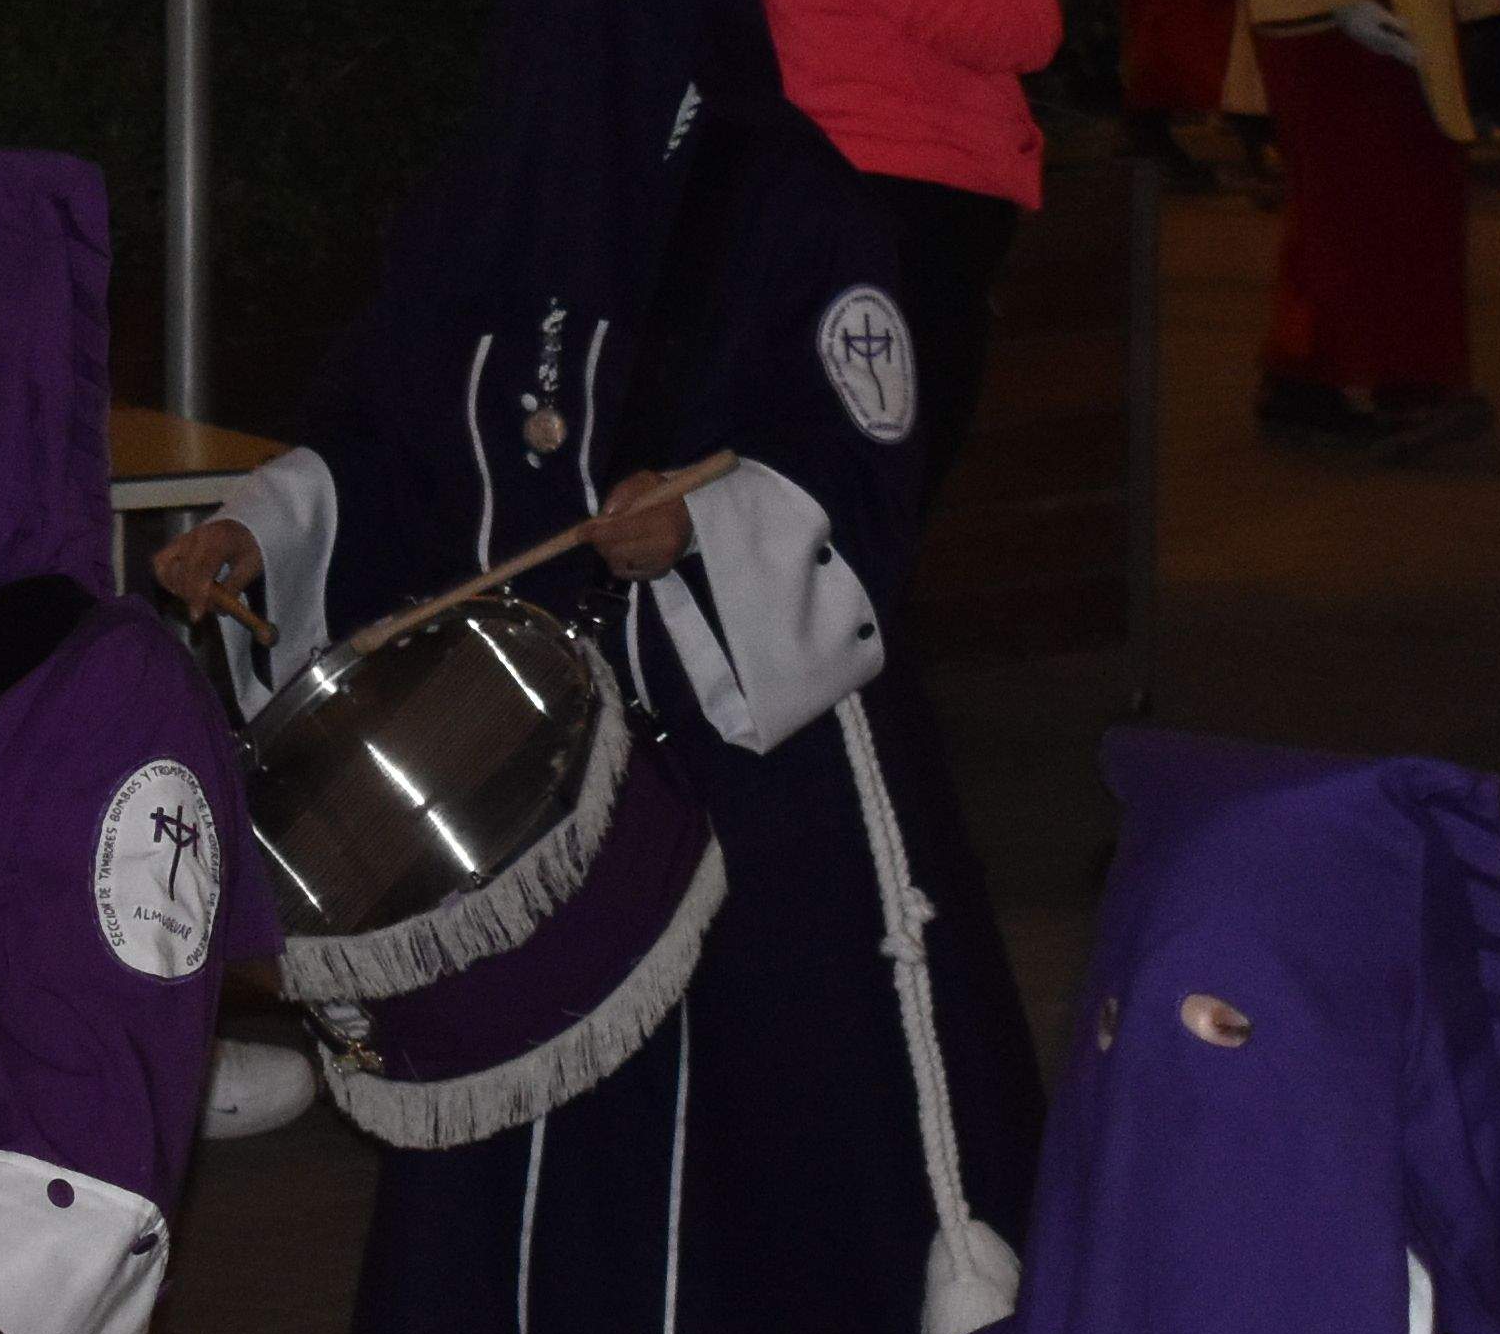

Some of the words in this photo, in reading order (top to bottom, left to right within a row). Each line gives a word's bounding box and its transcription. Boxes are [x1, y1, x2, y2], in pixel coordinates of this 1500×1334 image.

[140, 769, 152, 782] Y
[109, 779, 142, 823] BOMBOS
[98, 826, 118, 880] TAMBORES
[99, 886, 111, 899] DE
[101, 903, 126, 947] SECCION
